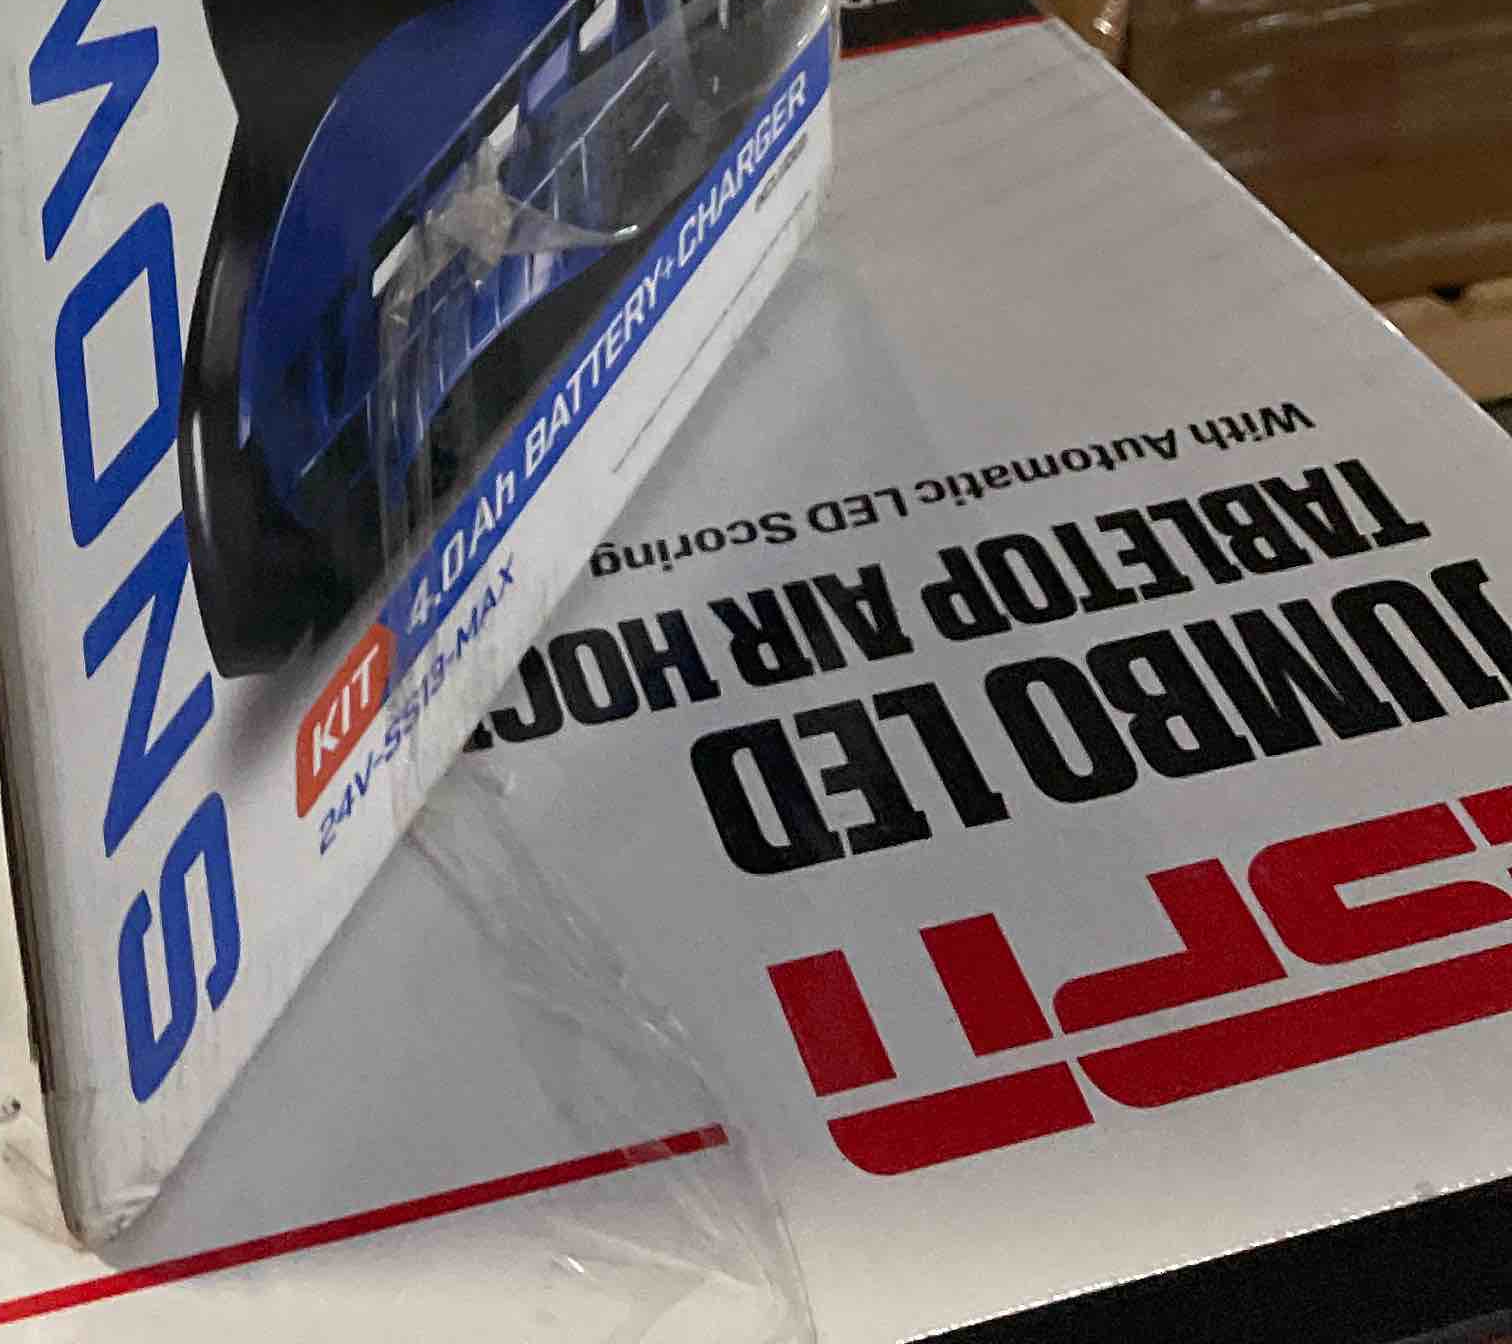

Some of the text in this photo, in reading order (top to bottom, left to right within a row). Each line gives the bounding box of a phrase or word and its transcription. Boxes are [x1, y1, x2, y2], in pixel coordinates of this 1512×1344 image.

[309, 646, 380, 780] KIT
[524, 264, 662, 481] BATTERY
[676, 69, 807, 269] CHARGER
[588, 401, 1315, 579] With Automatic LED Scoring
[918, 457, 1431, 644] TABLETOP
[688, 558, 1512, 878] JUMBO LED
[707, 564, 914, 690] AIR
[766, 785, 1512, 1177] SPN
